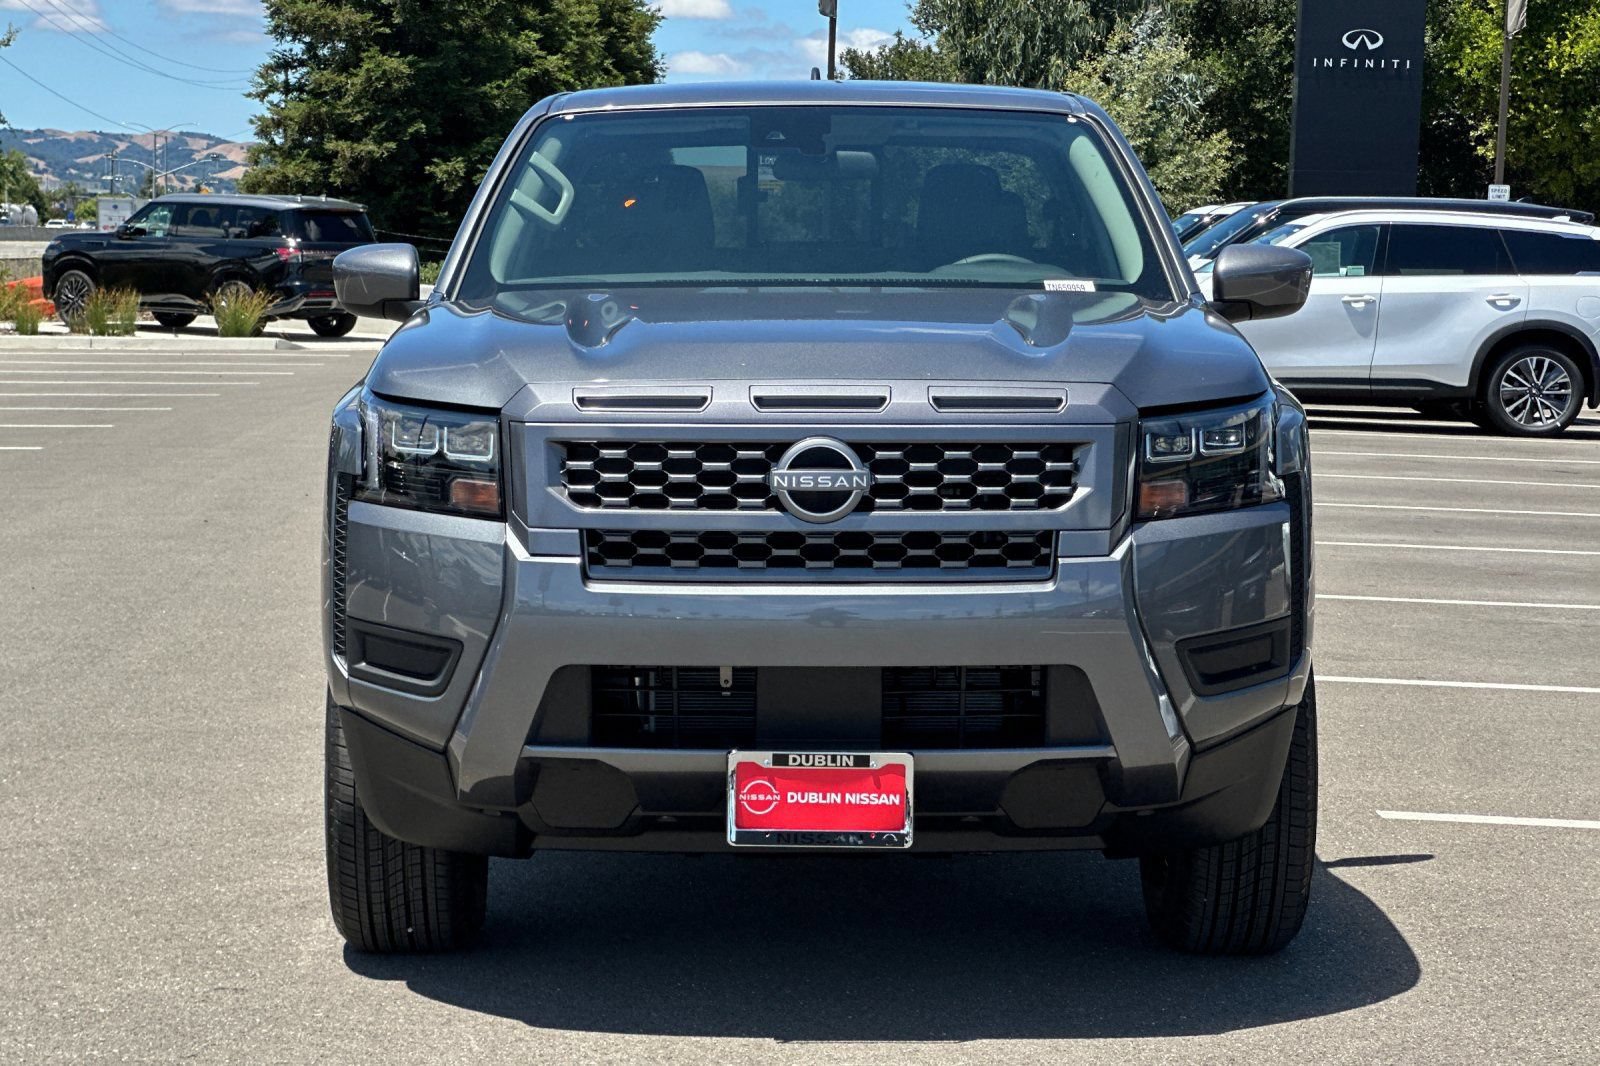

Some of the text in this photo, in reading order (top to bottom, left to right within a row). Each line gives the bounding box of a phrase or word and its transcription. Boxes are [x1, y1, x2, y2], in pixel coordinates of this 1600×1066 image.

[1313, 57, 1410, 69] INFINITI
[773, 475, 867, 488] NISSAN
[788, 754, 854, 767] DUBLIN
[787, 792, 900, 805] DUBLIN NISSAN
[775, 832, 864, 845] NISSAN
